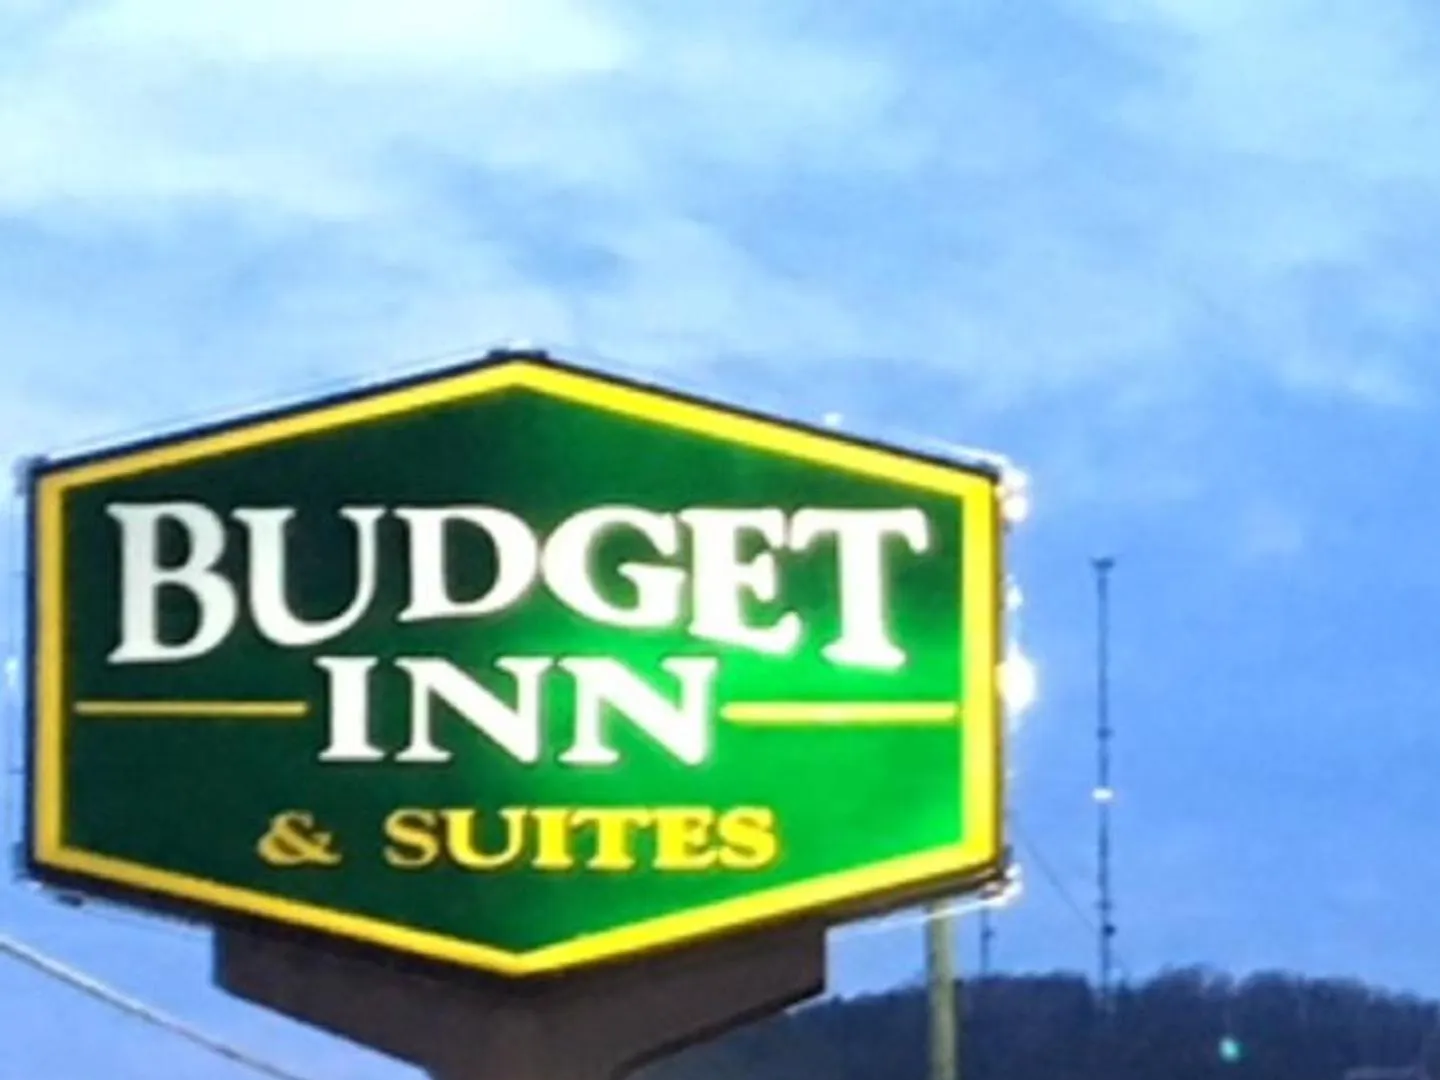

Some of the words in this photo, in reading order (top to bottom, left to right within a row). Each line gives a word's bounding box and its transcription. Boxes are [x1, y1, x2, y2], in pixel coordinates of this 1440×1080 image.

[106, 501, 929, 669] BUDGET
[315, 655, 721, 767] INN
[257, 811, 340, 864] &
[384, 806, 779, 871] SUITES
